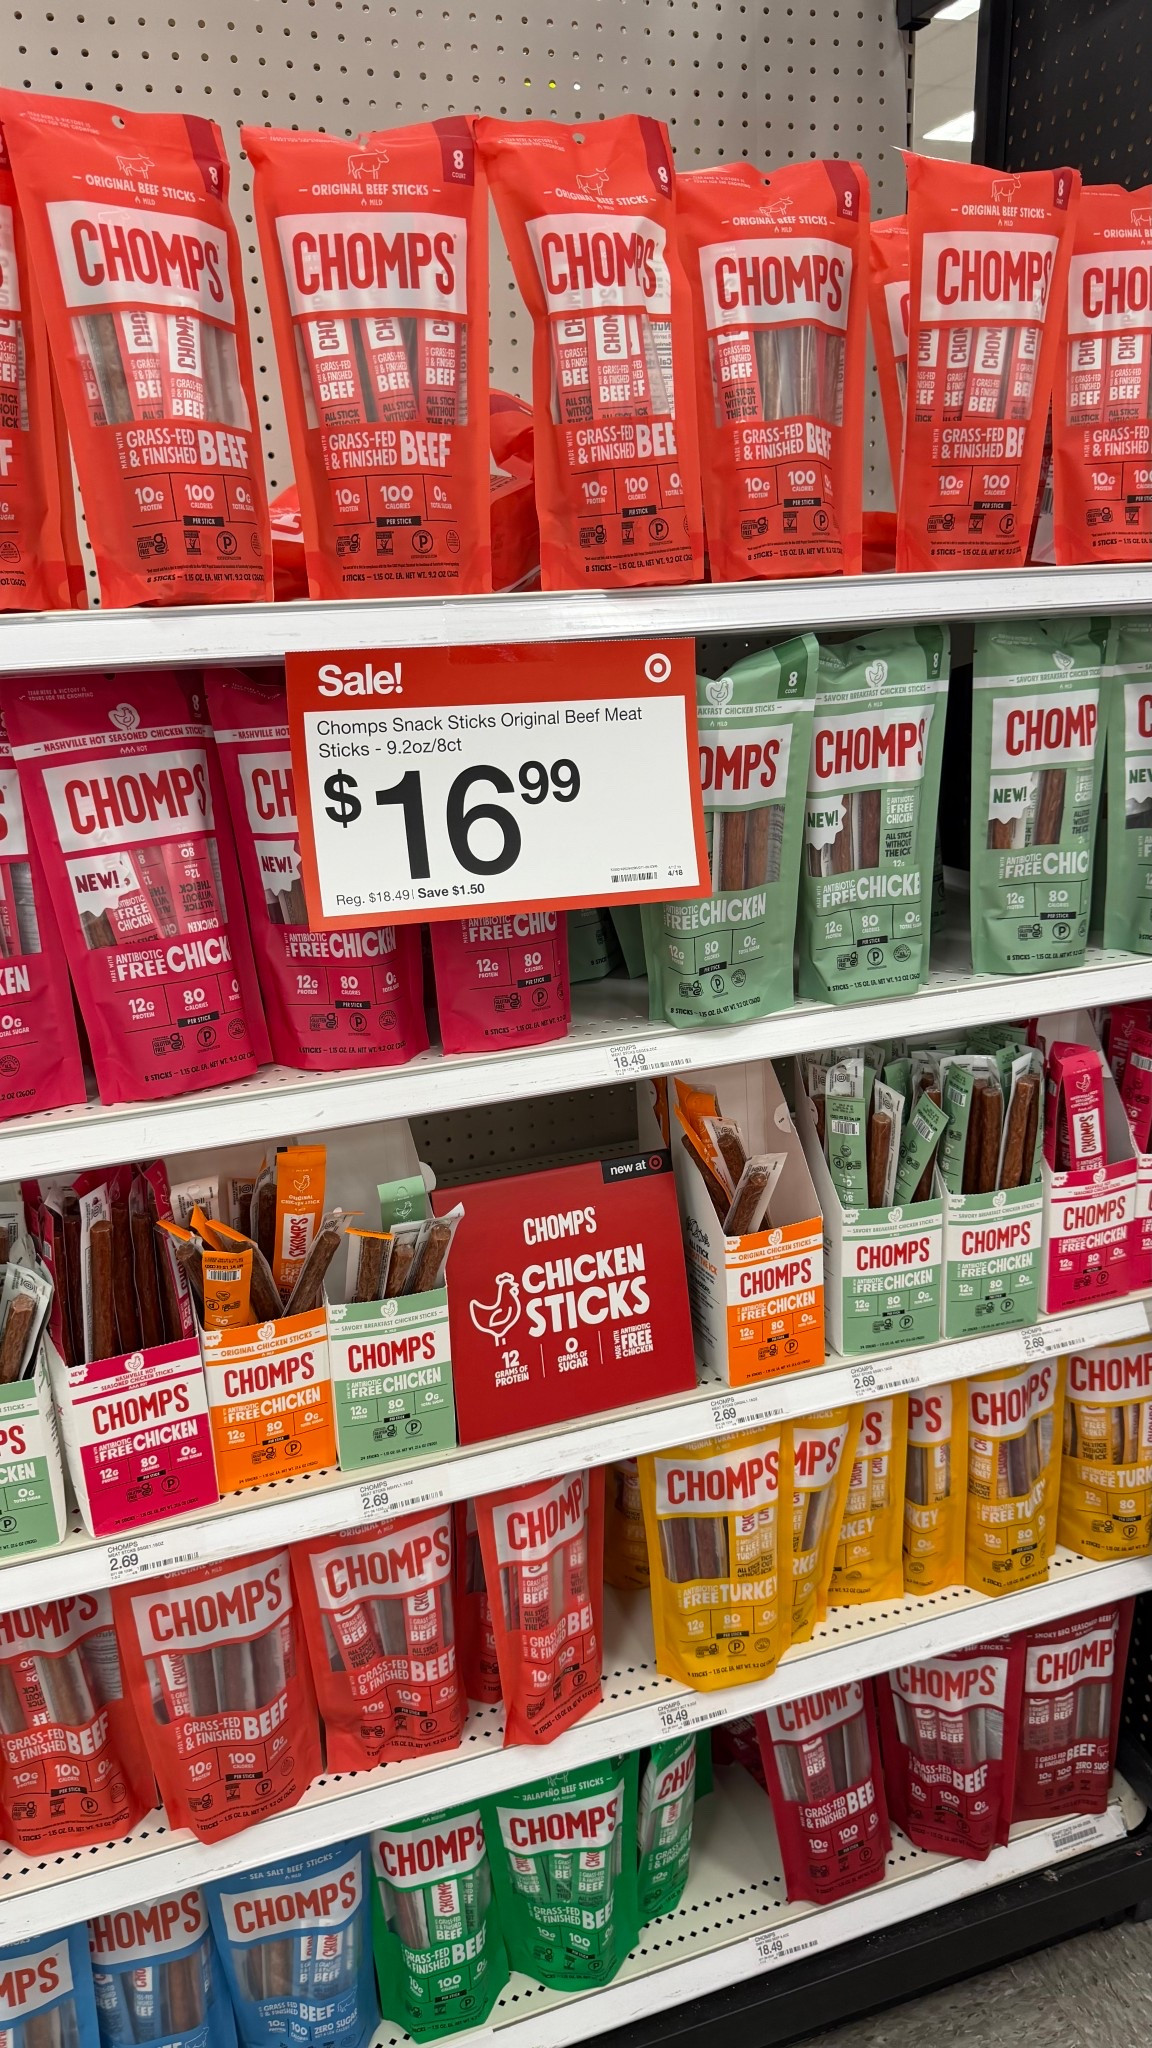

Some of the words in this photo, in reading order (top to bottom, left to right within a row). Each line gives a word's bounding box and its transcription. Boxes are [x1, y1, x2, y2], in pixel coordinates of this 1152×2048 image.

[452, 150, 464, 169] 8
[85, 174, 136, 192] ORIGINAL
[138, 181, 159, 196] BEEF
[162, 186, 196, 203] STICKS
[312, 183, 363, 195] ORIGINAL
[366, 184, 388, 195] BEEF
[392, 184, 429, 195] STICKS
[70, 219, 224, 303] CHOMPS
[292, 231, 455, 295] CHOMPS
[541, 232, 656, 297] CHOMPS
[714, 254, 844, 312] CHOMPS
[126, 428, 195, 448] GRASS-FED
[329, 430, 396, 450] GRASS-FED
[400, 430, 451, 468] BEEF
[129, 451, 141, 468] &
[142, 446, 197, 465] FINISHED
[198, 430, 249, 469] BEEF
[331, 453, 341, 470] &
[342, 449, 397, 468] FINISHED
[335, 488, 360, 505] 10G
[380, 485, 413, 502] 100
[385, 502, 411, 510] CALORIES
[316, 662, 404, 698] Sale!
[824, 693, 849, 702] SAVORY
[849, 688, 878, 699] BREAKFAST
[880, 686, 906, 695] CHICKEN
[907, 685, 926, 693] STICKS
[316, 719, 388, 738] Chomps
[392, 716, 443, 733] Snack
[446, 713, 497, 730] Sticks
[500, 709, 561, 731] Original
[565, 708, 601, 725] Beef
[604, 706, 643, 723] Meat
[44, 737, 87, 753] NASHVILLE
[89, 735, 107, 745] HOT
[109, 730, 148, 743] SEASONED
[151, 727, 184, 738] CHICKEN
[318, 742, 370, 758] Sticks
[386, 738, 463, 756] 9.2oz/8ct
[815, 717, 925, 779] CHOMPS
[64, 763, 207, 834] CHOMPS
[993, 786, 1027, 803] NEW!
[807, 809, 840, 829] NEW!
[75, 870, 120, 893] NEW!
[336, 895, 365, 906] Reg.
[369, 889, 410, 904] $18.49
[418, 888, 449, 898] Save
[452, 883, 485, 896] $1.50
[700, 892, 766, 926] CHICKEN
[118, 958, 168, 982] FREE
[128, 997, 155, 1014] 12G
[183, 988, 205, 1004] 80
[610, 1045, 637, 1053] CHOMPS
[614, 1053, 646, 1068] 18.49
[1080, 1113, 1094, 1153] CHOMPS
[610, 1163, 633, 1177] new
[635, 1160, 647, 1171] at
[1062, 1195, 1126, 1231] CHOMPS
[523, 1206, 597, 1246] CHOMPS
[288, 1217, 309, 1258] CHOMPS
[962, 1221, 1031, 1256] CHOMPS
[1086, 1226, 1127, 1249] CHICKEN
[856, 1237, 930, 1271] CHOMPS
[987, 1252, 1033, 1274] CHICKEN
[521, 1243, 646, 1294] CHICKEN
[740, 1258, 812, 1298] CHOMPS
[883, 1269, 933, 1290] CHICKEN
[526, 1275, 650, 1338] STICKS
[767, 1290, 816, 1315] CHICKEN
[341, 1323, 362, 1332] SAVORY
[363, 1320, 394, 1329] BREAKFAST
[394, 1315, 418, 1325] CHICKEN
[419, 1311, 438, 1321] STICKS
[620, 1323, 651, 1334] ANTIBIOTIC
[220, 1346, 255, 1357] ORIGINAL
[256, 1338, 288, 1350] CHICKEN
[289, 1331, 313, 1344] STICKS
[565, 1337, 579, 1352] 0
[621, 1329, 652, 1350] FREE
[622, 1343, 654, 1357] CHICKEN
[1024, 1337, 1044, 1350] 2.69
[348, 1332, 435, 1373] CHOMPS
[502, 1350, 520, 1369] 12
[557, 1352, 579, 1363] GRAMS
[579, 1350, 587, 1358] OF
[70, 1369, 85, 1378] NEW!
[114, 1370, 140, 1382] NASHVILLE
[142, 1368, 156, 1376] HOT
[224, 1351, 315, 1398] CHOMPS
[495, 1368, 518, 1379] GRAMS
[519, 1365, 528, 1374] OF
[558, 1357, 588, 1372] SUGAR
[100, 1379, 127, 1392] SEASONED
[127, 1374, 152, 1386] CHICKEN
[153, 1367, 174, 1380] STICKS
[382, 1367, 442, 1393] CHICKEN
[495, 1372, 529, 1387] PROTEIN
[854, 1375, 875, 1389] 2.69
[260, 1386, 321, 1417] CHICKEN
[970, 1366, 1052, 1428] CHOMPS
[92, 1383, 190, 1435] CHOMPS
[714, 1408, 736, 1422] 2.69
[132, 1419, 198, 1452] CHICKEN
[360, 1481, 388, 1493] CHOMPS
[666, 1450, 780, 1505] CHOMPS
[362, 1493, 389, 1510] 2.69
[107, 1541, 138, 1553] CHOMPS
[110, 1554, 139, 1571] 2.69
[324, 1527, 450, 1598] CHOMPS
[719, 1575, 778, 1603] TURKEY
[148, 1566, 282, 1642] CHOMPS
[183, 1716, 241, 1736] GRASS-FED
[242, 1693, 288, 1741] BEEF
[661, 1710, 688, 1726] 18.49
[196, 1728, 242, 1746] FINISHED
[1067, 1744, 1096, 1761] BEEF
[561, 1783, 577, 1795] BEEF
[578, 1777, 604, 1791] STICKS
[953, 1765, 988, 1793] BEEF
[805, 1796, 845, 1819] GRASS-FED
[815, 1808, 847, 1829] FINISHED
[508, 1796, 618, 1848] CHOMPS
[249, 1871, 264, 1880] SEA
[266, 1868, 285, 1877] SALT
[286, 1863, 304, 1874] BEEF
[305, 1852, 334, 1868] STICKS
[233, 1870, 356, 1934] CHOMPS
[758, 1940, 783, 1956] 18.49
[300, 2003, 335, 2022] BEEF
[314, 2024, 334, 2034] ZERO
